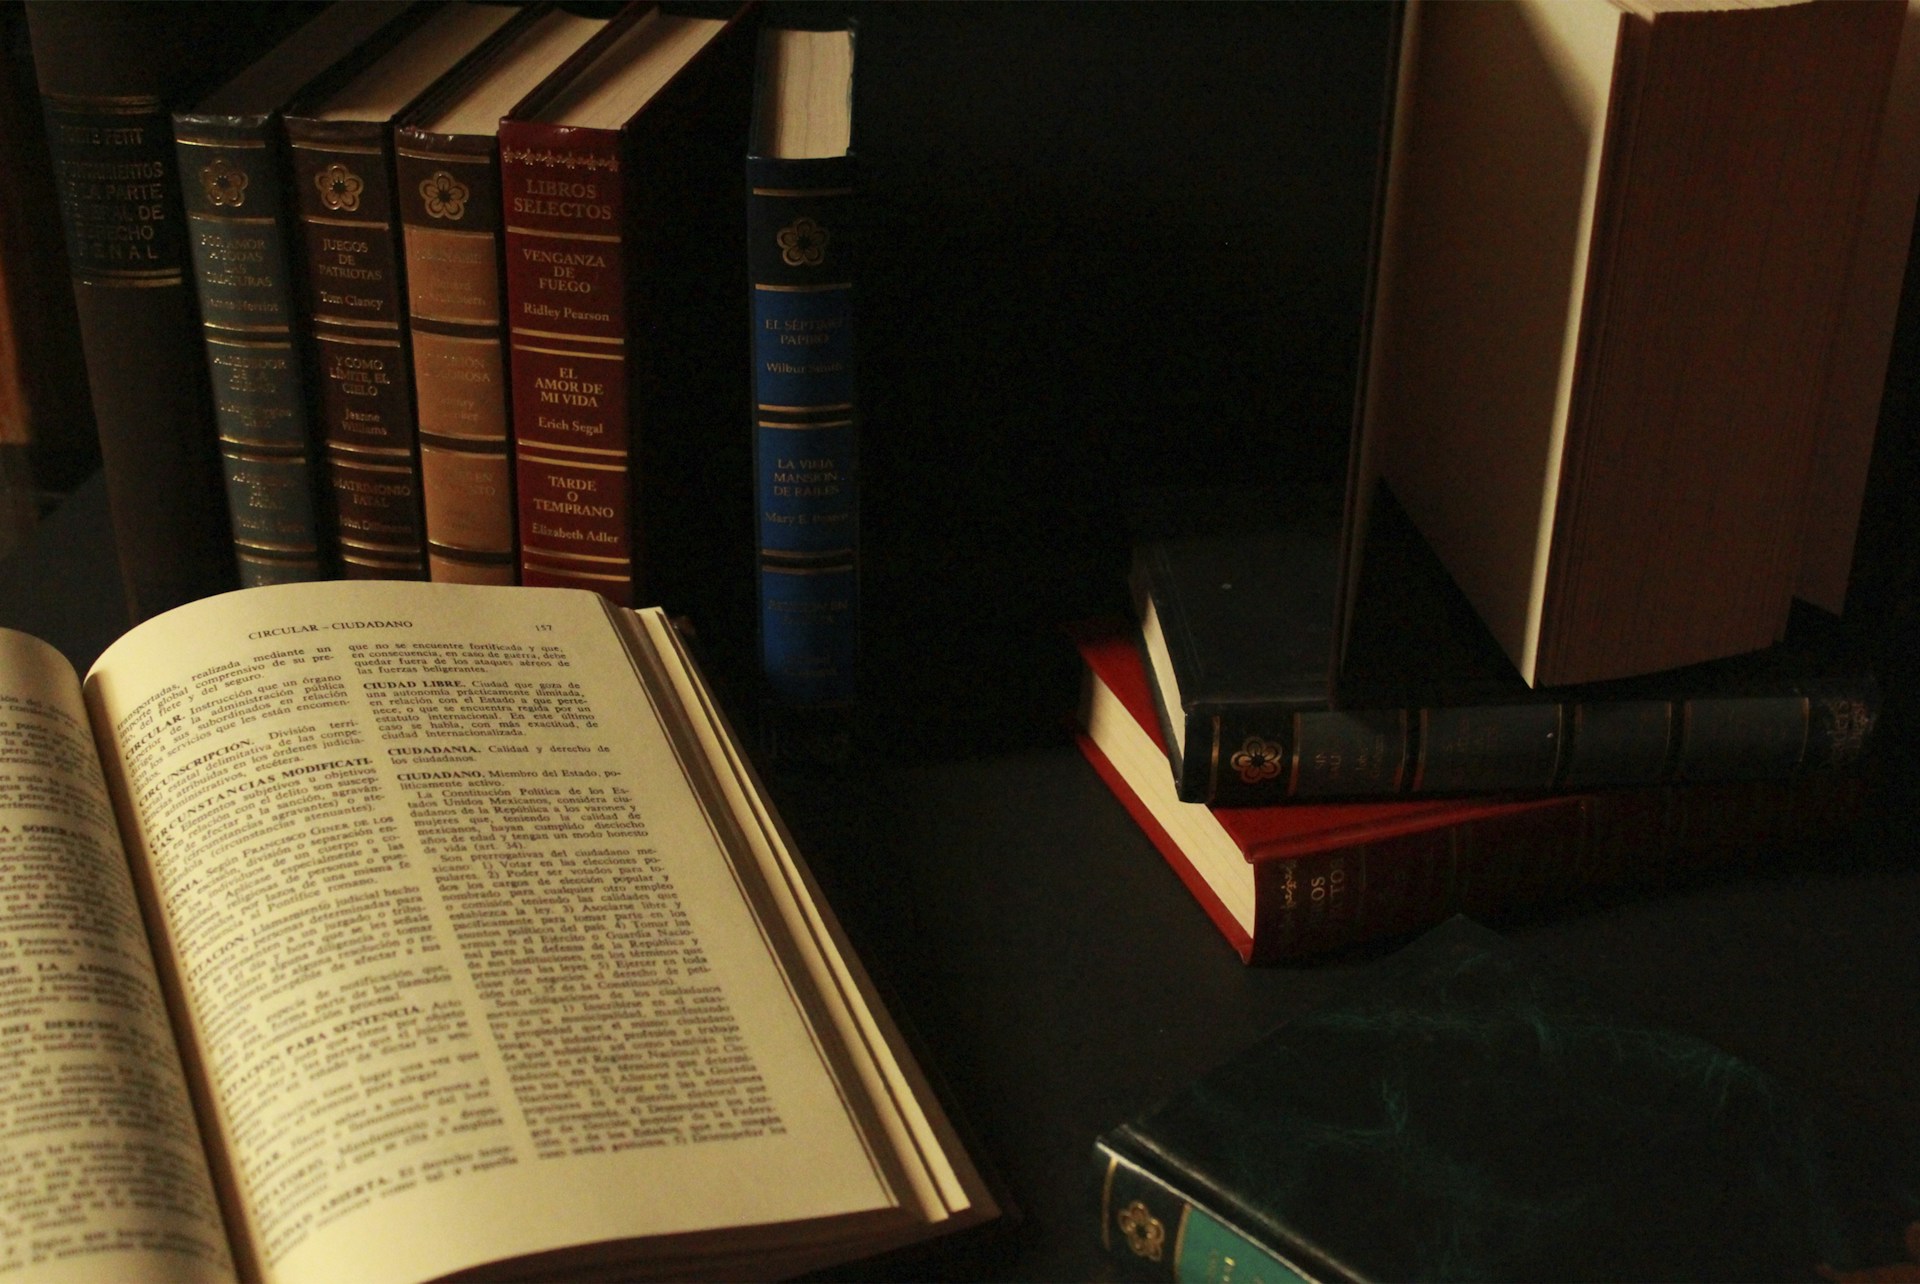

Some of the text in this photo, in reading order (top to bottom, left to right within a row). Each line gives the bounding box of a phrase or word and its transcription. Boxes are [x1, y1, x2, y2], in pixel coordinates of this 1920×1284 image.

[526, 179, 597, 199] LIBROS
[138, 204, 165, 220] DE
[514, 197, 613, 221] SELECTOS
[323, 238, 369, 253] JUEGOS
[338, 253, 356, 266] DE
[522, 248, 607, 268] VENGANZA
[318, 263, 383, 281] PATRIOTAS
[553, 266, 576, 279] DE
[539, 277, 592, 294] FUEGO
[320, 290, 384, 311] Tom Clancy
[524, 303, 610, 322] Ridley Pearson
[765, 319, 779, 330] EL
[344, 357, 384, 370] COMO
[766, 362, 806, 373] Wilbur
[559, 367, 578, 380] EL
[342, 382, 378, 397] CIELO
[535, 377, 605, 396] AMOR DE
[540, 391, 599, 408] MI VIDA
[538, 417, 604, 437] Erich Segal
[778, 459, 796, 470] LA
[547, 475, 597, 492] TARDE
[567, 492, 579, 503] O
[774, 486, 791, 496] DE
[533, 498, 615, 519] TEMPRANO
[531, 522, 620, 544] Elizabeth Adler
[248, 620, 413, 641] CIRCULAR CIUDADANO
[535, 624, 553, 632] 157
[348, 643, 369, 652] que
[412, 642, 465, 650] encuentre
[469, 641, 523, 651] fortificada
[354, 657, 393, 668] quedar
[399, 657, 429, 665] fuera
[434, 656, 448, 665] de
[453, 656, 470, 665] los
[473, 658, 514, 668] ataques
[557, 659, 571, 668] de
[487, 650, 501, 658] de
[543, 651, 567, 660] debe
[190, 660, 241, 681] realizada
[253, 648, 305, 662] mediante
[194, 663, 265, 688] comprensivo
[272, 658, 286, 667] de
[312, 654, 334, 663] pre-
[358, 667, 374, 675] las
[379, 665, 419, 674] fuerzas
[363, 680, 417, 690] CIUDAD
[472, 679, 510, 688] Ciudad
[514, 682, 534, 691] que
[539, 682, 563, 691] goza
[568, 681, 581, 690] de
[189, 673, 342, 715] Instrucción que un órgano
[210, 682, 345, 715] administración pública
[302, 690, 348, 705] relación
[393, 688, 451, 697] autonomía
[296, 699, 350, 711] encomen-
[389, 696, 434, 706] relación
[464, 695, 475, 704] el
[480, 695, 516, 704] Estado
[533, 698, 553, 706] que
[557, 697, 588, 707] perte-
[419, 706, 439, 715] que
[460, 704, 514, 713] encuentra
[518, 703, 551, 714] regida
[554, 706, 573, 714] por
[376, 715, 421, 725] estatuto
[510, 711, 526, 720] En
[533, 712, 555, 720] este
[561, 712, 596, 721] último
[268, 726, 316, 744] División
[488, 744, 530, 754] Calidad
[550, 744, 592, 753] derecho
[597, 745, 611, 753] de
[392, 756, 409, 765] los
[281, 757, 373, 779] MODIFICATI-
[488, 769, 539, 778] Miembro
[542, 768, 559, 777] del
[604, 771, 622, 779] po-
[418, 790, 434, 799] La
[442, 788, 512, 798] Constitución
[568, 786, 583, 795] de
[589, 786, 605, 795] los
[613, 786, 630, 795] Es-
